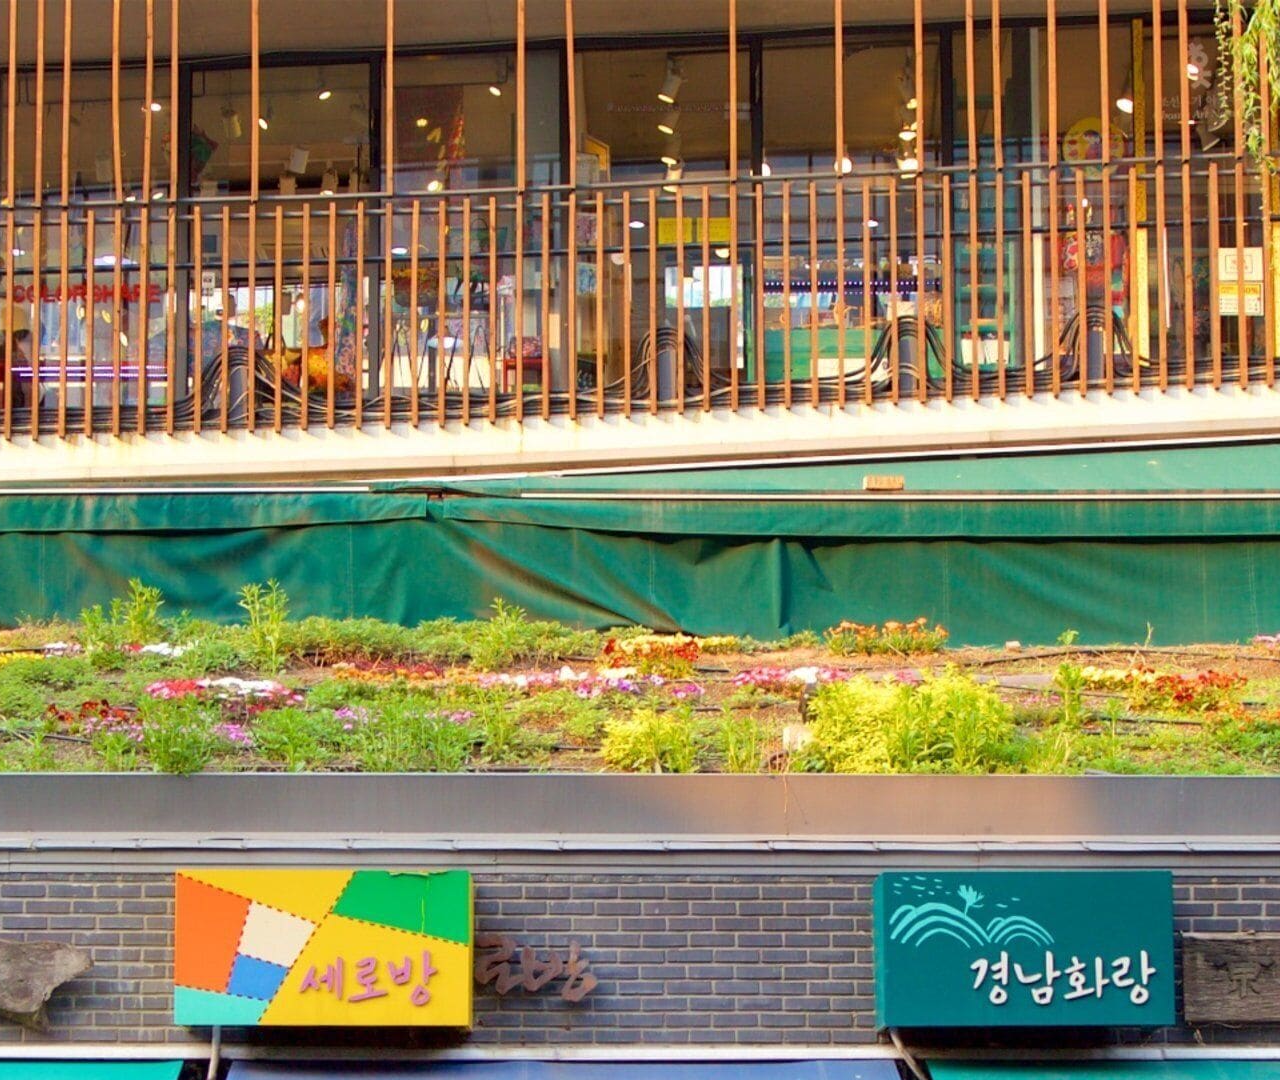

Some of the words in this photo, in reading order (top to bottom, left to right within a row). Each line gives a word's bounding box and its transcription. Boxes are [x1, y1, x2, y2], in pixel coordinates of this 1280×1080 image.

[298, 950, 439, 1006] 세로방
[475, 934, 599, 1003] 로방
[971, 949, 1156, 1007] 경남화랑
